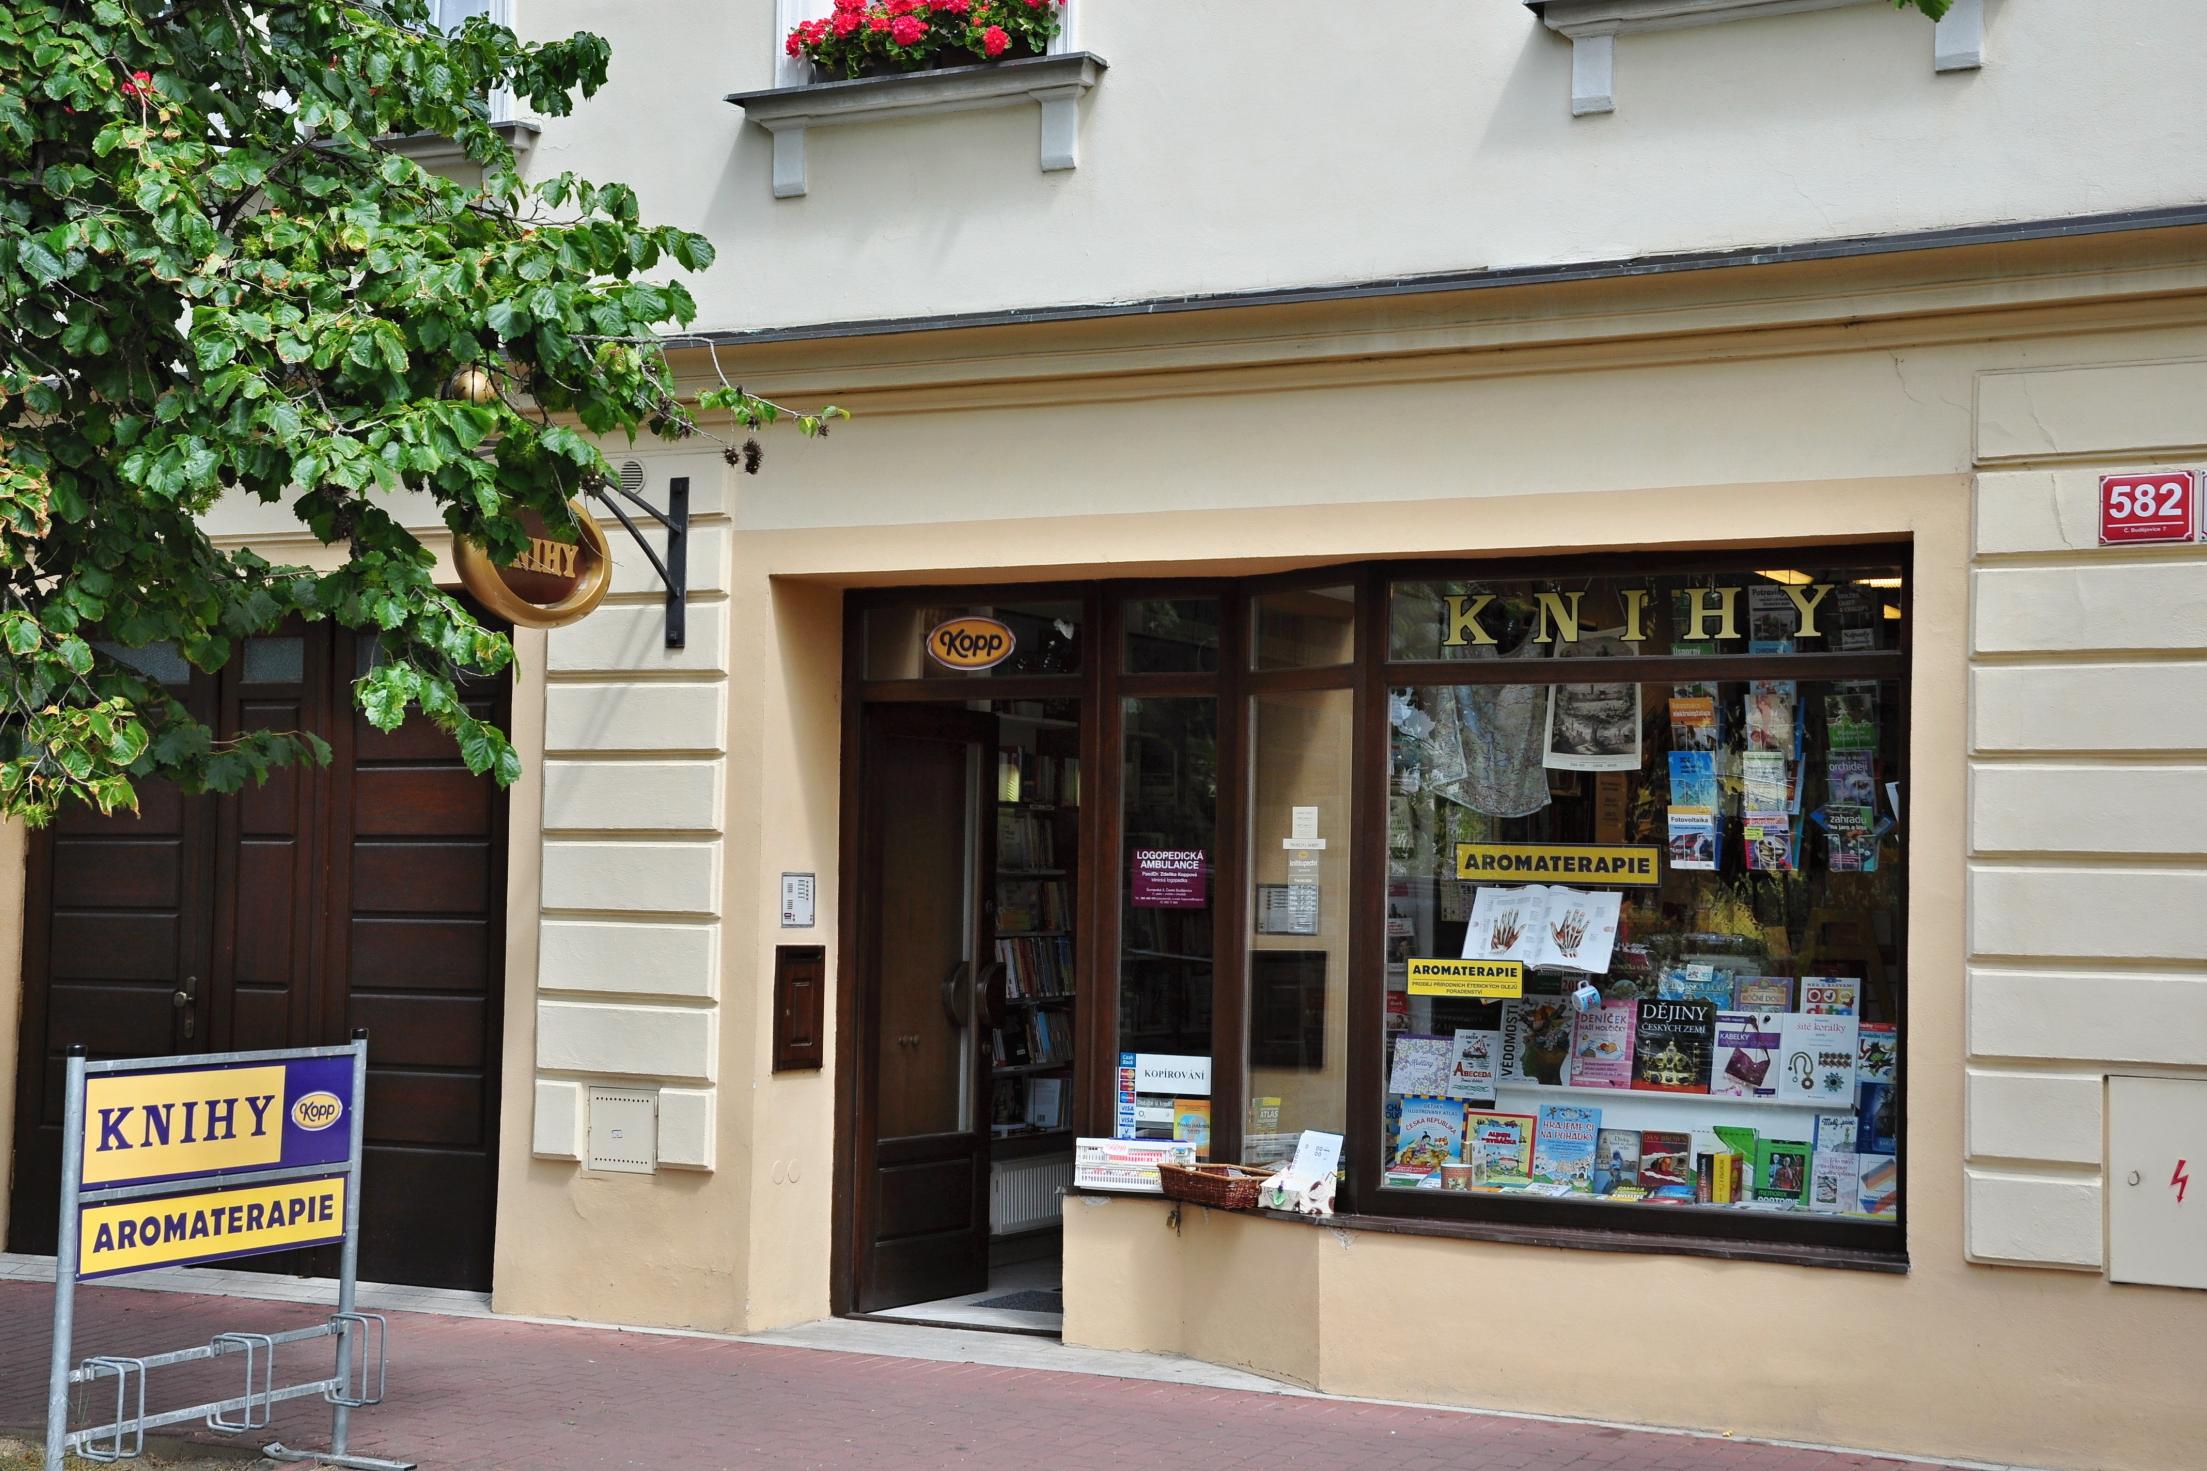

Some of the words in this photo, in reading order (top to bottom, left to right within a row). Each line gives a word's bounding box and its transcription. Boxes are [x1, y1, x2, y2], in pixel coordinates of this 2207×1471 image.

[2109, 482, 2183, 518] 582
[508, 536, 579, 578] NIHY
[1442, 584, 1835, 647] KNIHY
[939, 628, 1004, 659] Kopp
[1136, 850, 1204, 860] LOGOPEDICKÁ
[1140, 860, 1200, 870] AMBULANCE
[1464, 852, 1651, 876] AROMATERAPIE
[1412, 964, 1518, 978] AROMATERAPIE
[1580, 1012, 1627, 1025] DENÍČEK
[1642, 1002, 1708, 1023] DĚJINY
[1641, 1022, 1681, 1033] ČESKÝCH
[1681, 1024, 1706, 1034] ZEMÍ
[1501, 1004, 1519, 1077] VĚDOMOSTI
[1720, 1033, 1750, 1041] KABELKY
[1144, 1067, 1205, 1080] KOPÍROVÁNÍ
[1453, 1061, 1492, 1078] ABECEDA
[1260, 1110, 1279, 1118] ATLAS
[95, 1095, 276, 1153] KNIHY
[299, 1101, 335, 1122] Kopp
[1427, 1116, 1457, 1135] REPUBLIKA
[1543, 1120, 1583, 1131] HRAJEME
[1541, 1131, 1553, 1139] NA
[92, 1194, 334, 1254] AROMATERAPIE
